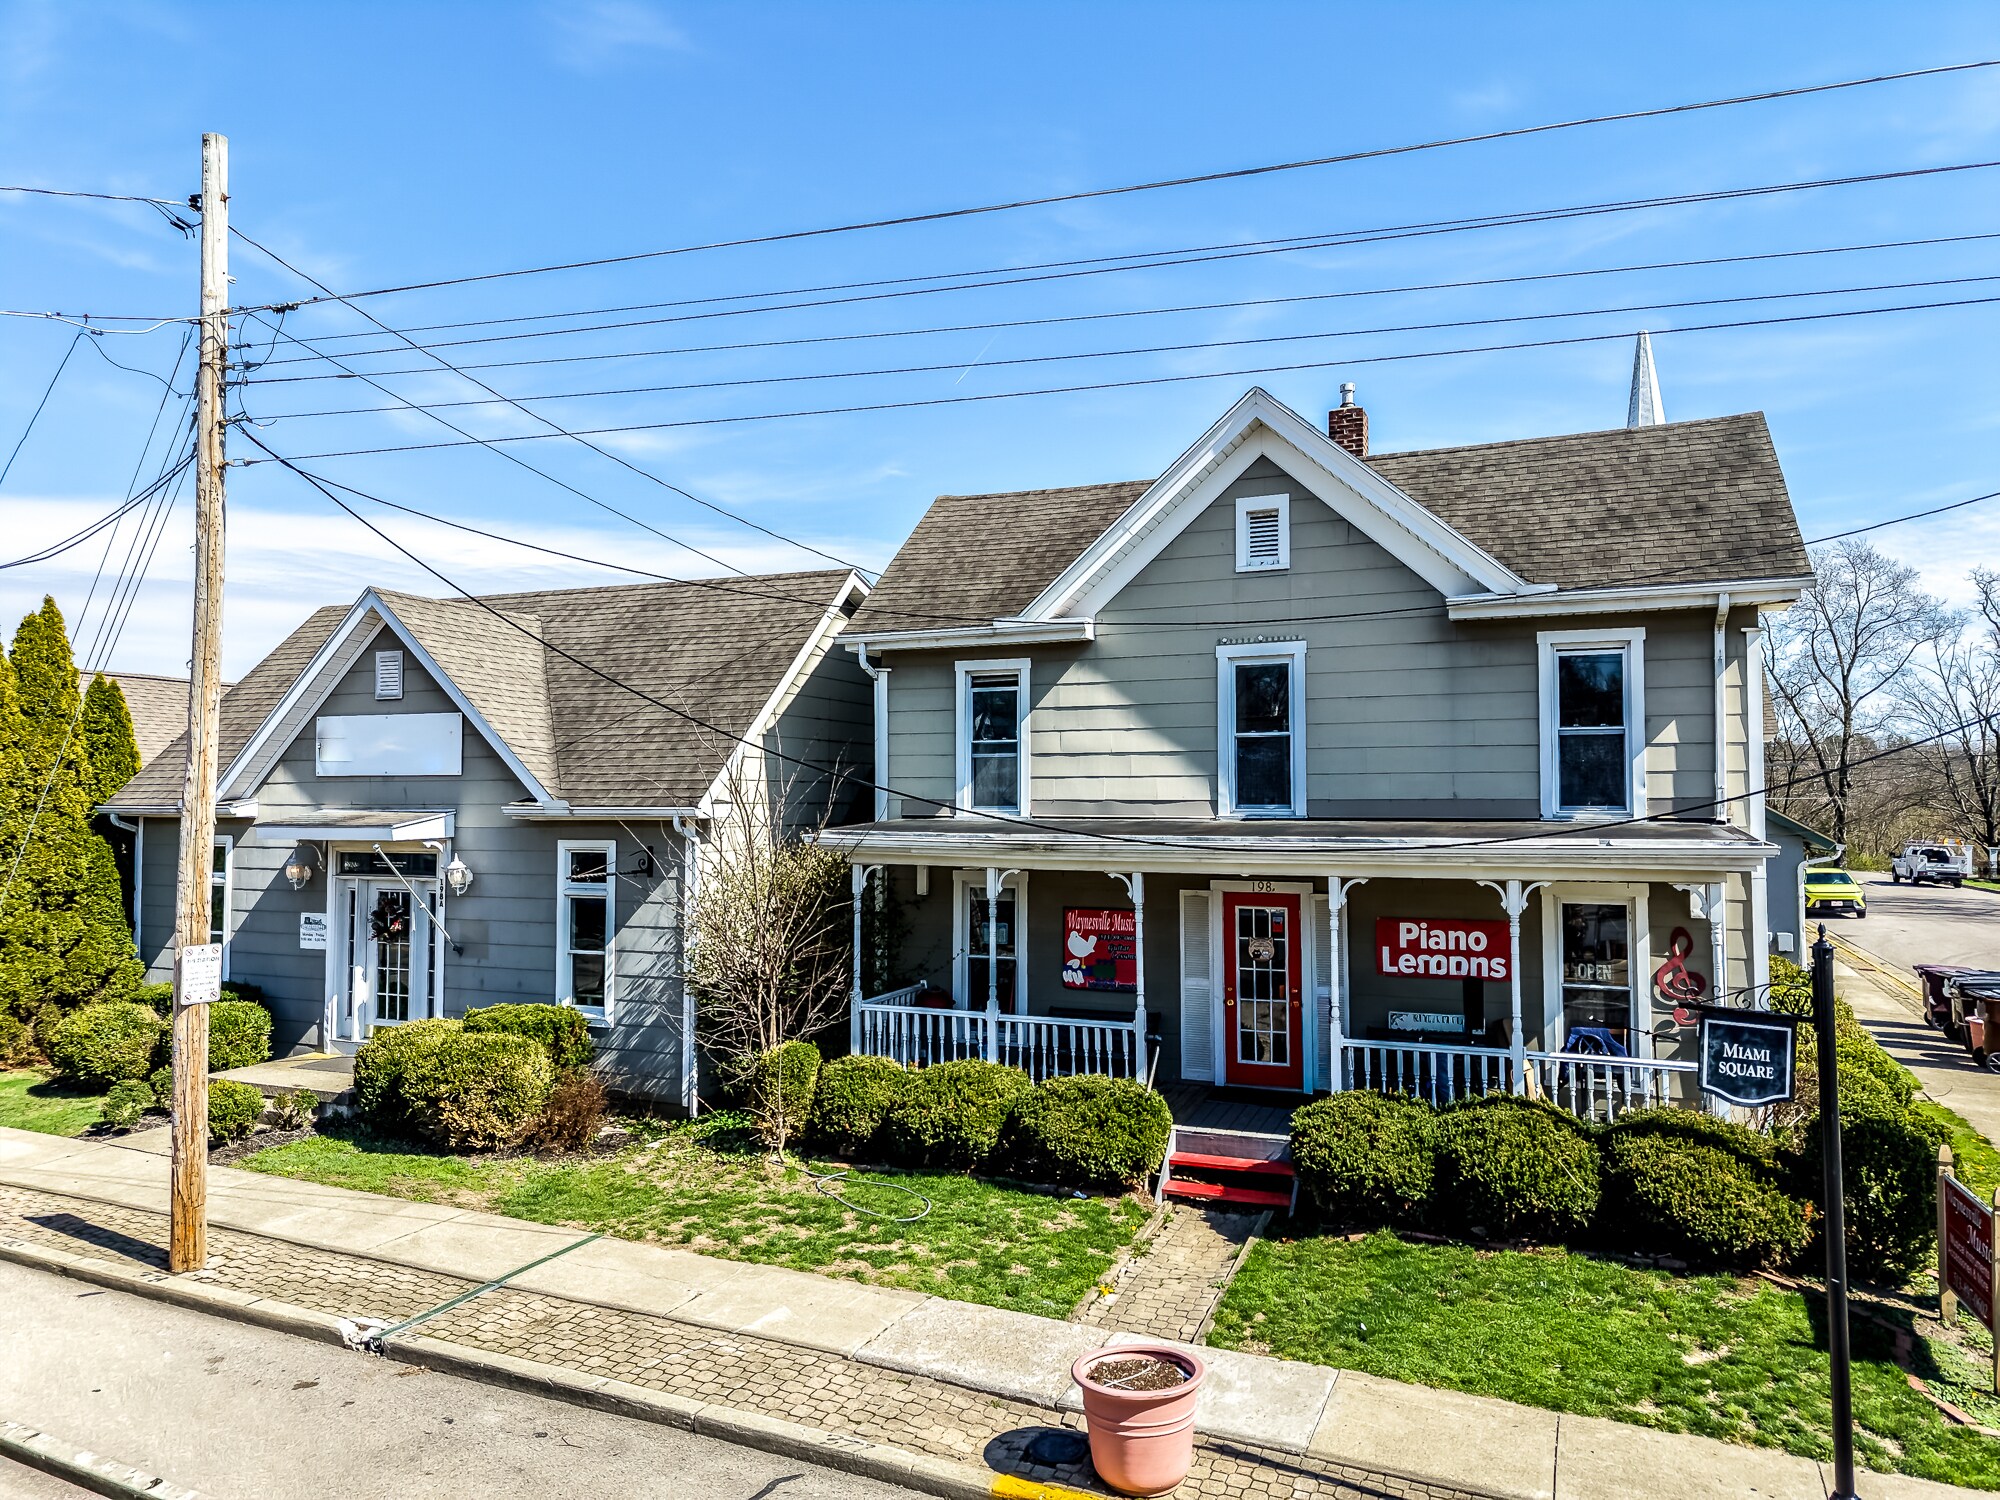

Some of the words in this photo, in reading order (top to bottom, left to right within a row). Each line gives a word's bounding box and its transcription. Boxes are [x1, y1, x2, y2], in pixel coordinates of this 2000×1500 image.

[1252, 881, 1272, 892] 198
[1067, 910, 1110, 936] Waynesville
[1111, 913, 1135, 932] Music
[1399, 922, 1488, 952] Piano
[1577, 963, 1612, 980] OPEN
[1722, 1041, 1771, 1062] MIAMI
[1718, 1061, 1775, 1080] SQUARE
